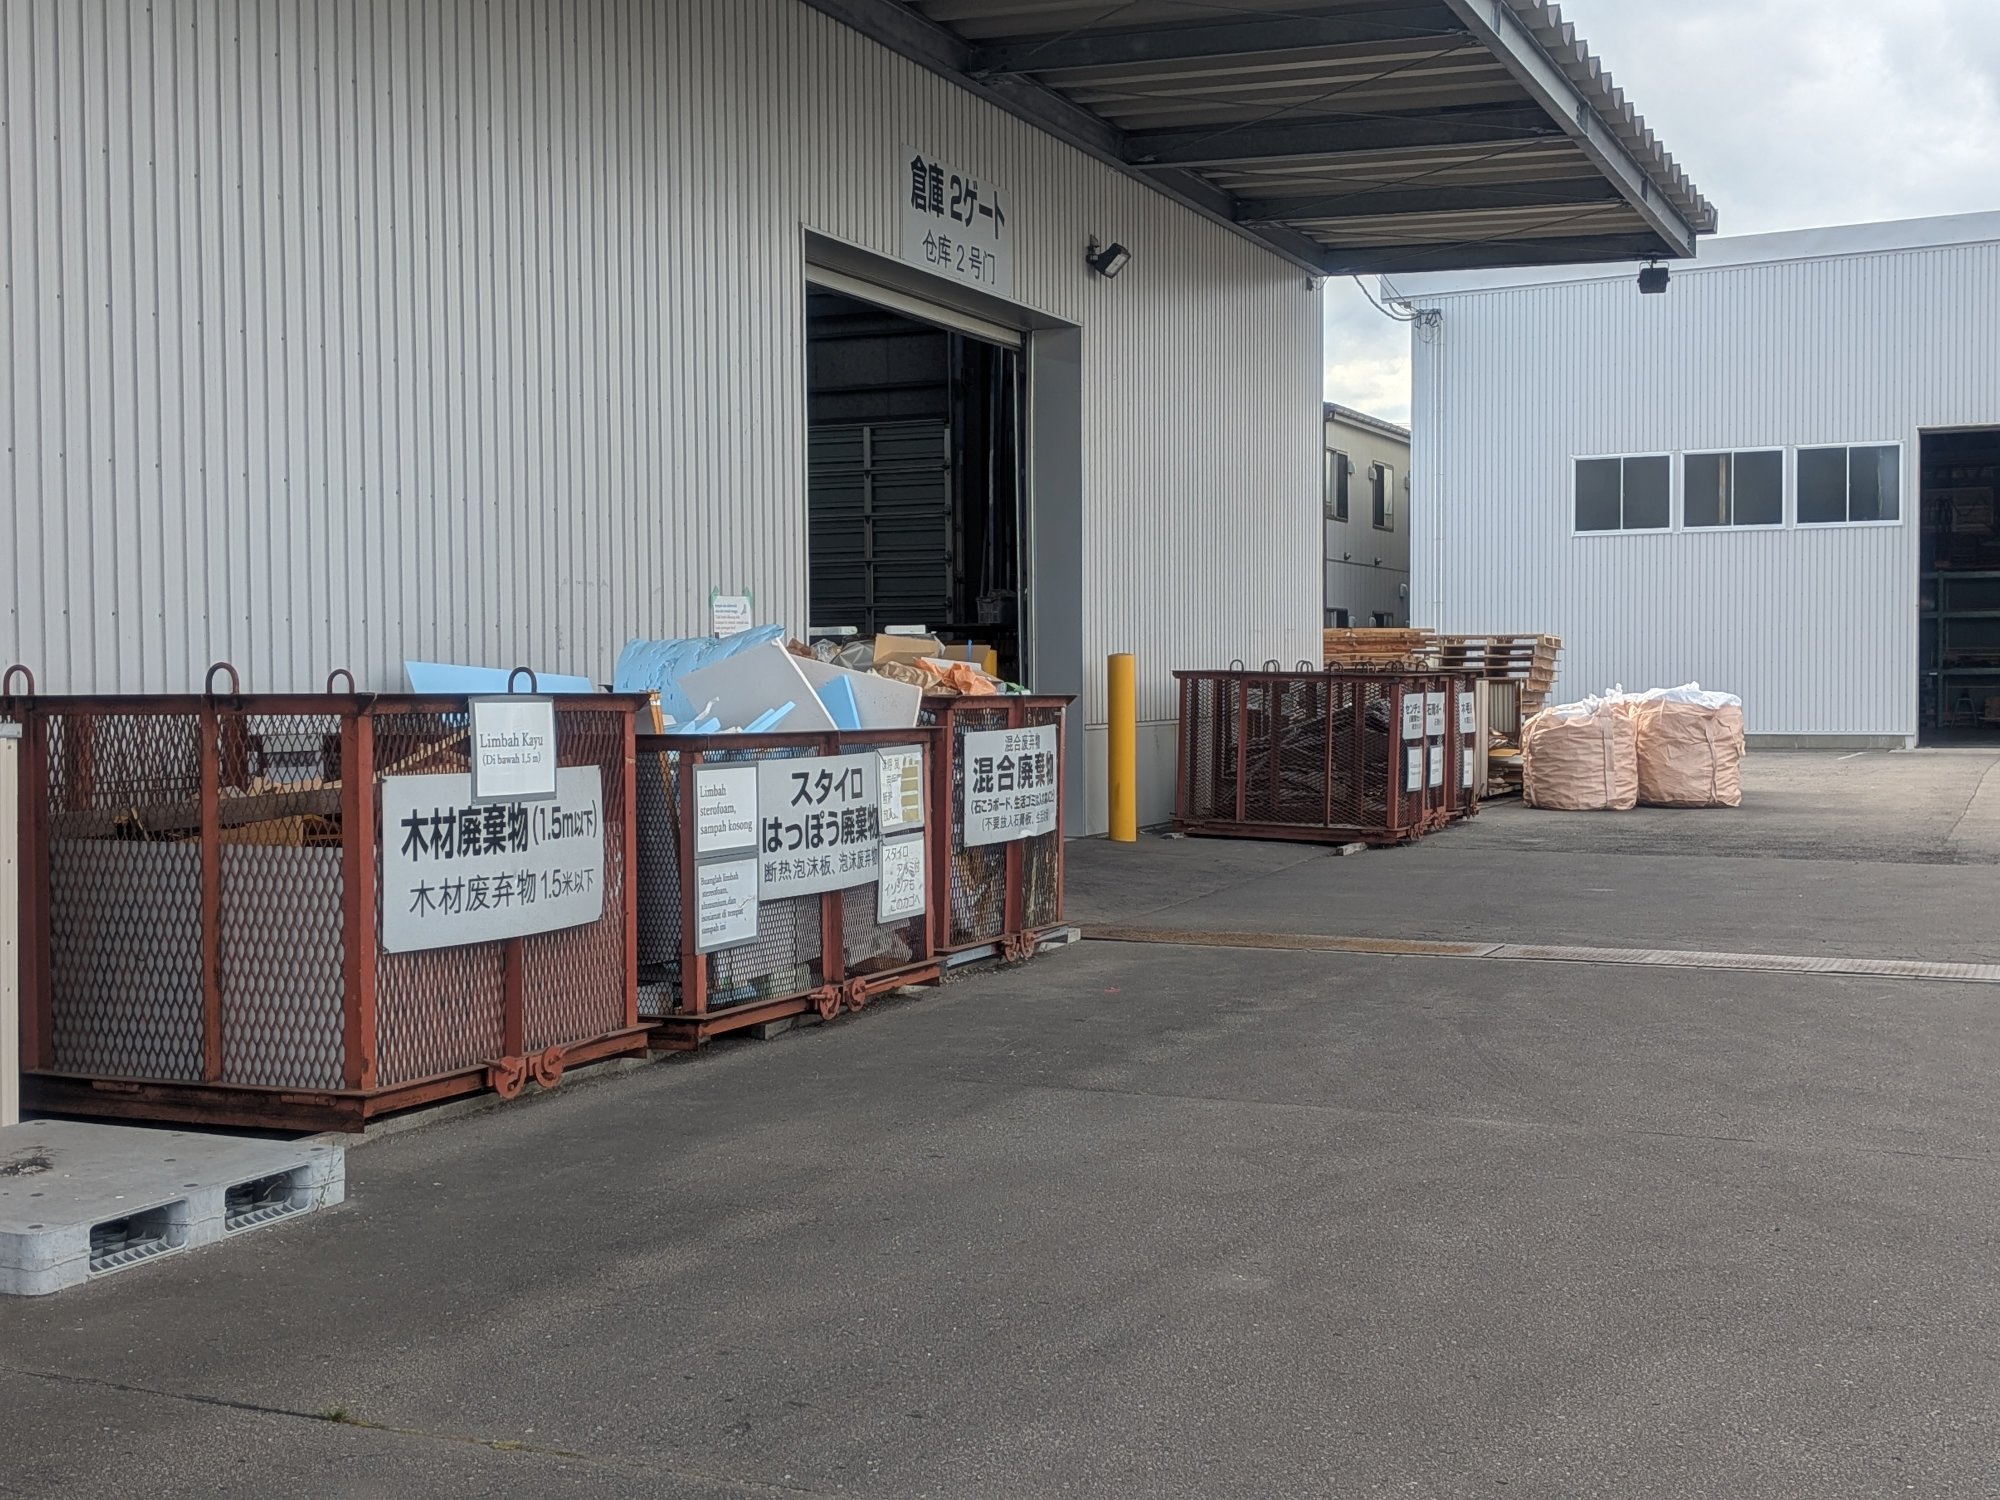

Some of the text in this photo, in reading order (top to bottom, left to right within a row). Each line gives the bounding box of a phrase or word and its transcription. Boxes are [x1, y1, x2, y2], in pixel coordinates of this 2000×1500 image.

[479, 732, 544, 751] Limbah Kayu
[482, 754, 496, 767] (Di
[497, 752, 520, 765] bawah
[972, 750, 1054, 794] 混合廃棄物
[699, 783, 727, 799] Limbah
[790, 767, 863, 807] スタイロ
[699, 802, 737, 817] sterofoam,
[699, 818, 753, 837] sampah kosong
[762, 803, 880, 854] はっぽう廃棄物
[884, 845, 909, 862] スタイロ
